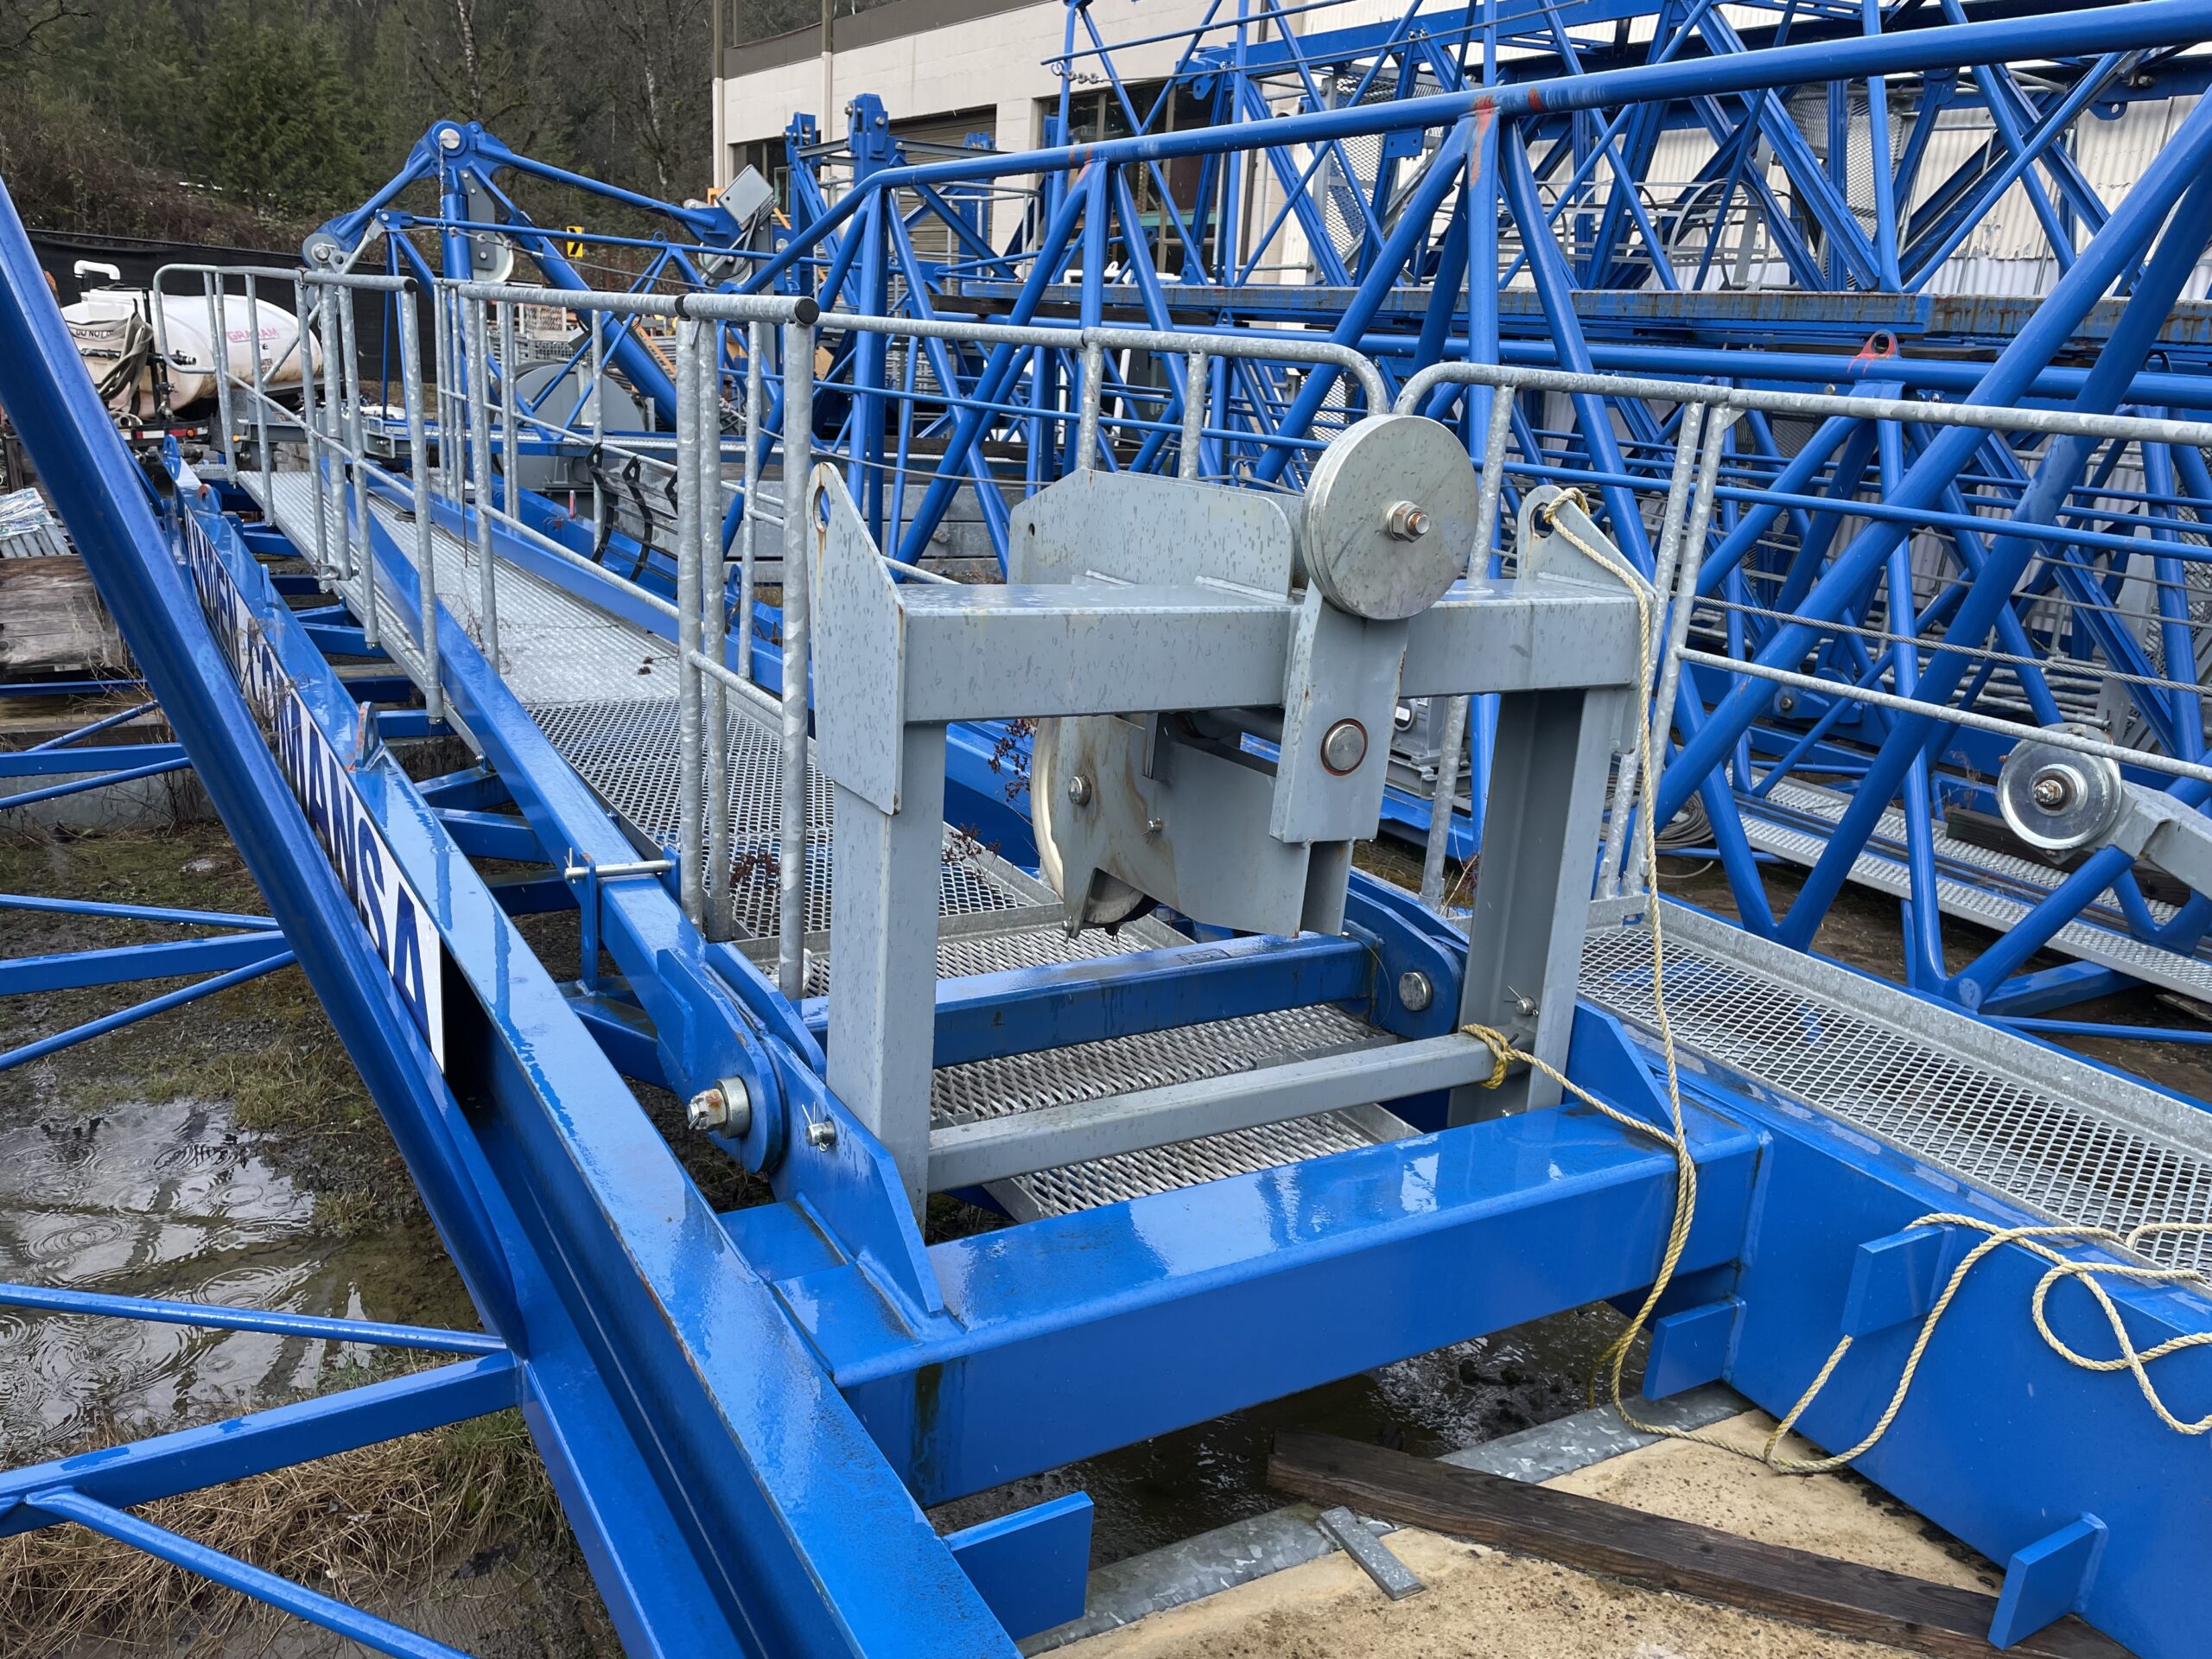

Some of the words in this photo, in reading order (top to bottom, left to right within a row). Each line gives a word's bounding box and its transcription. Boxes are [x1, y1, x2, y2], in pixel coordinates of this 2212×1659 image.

[226, 327, 278, 342] GRAAM
[185, 508, 242, 678] LINDEN
[248, 617, 431, 1050] COMANSA
